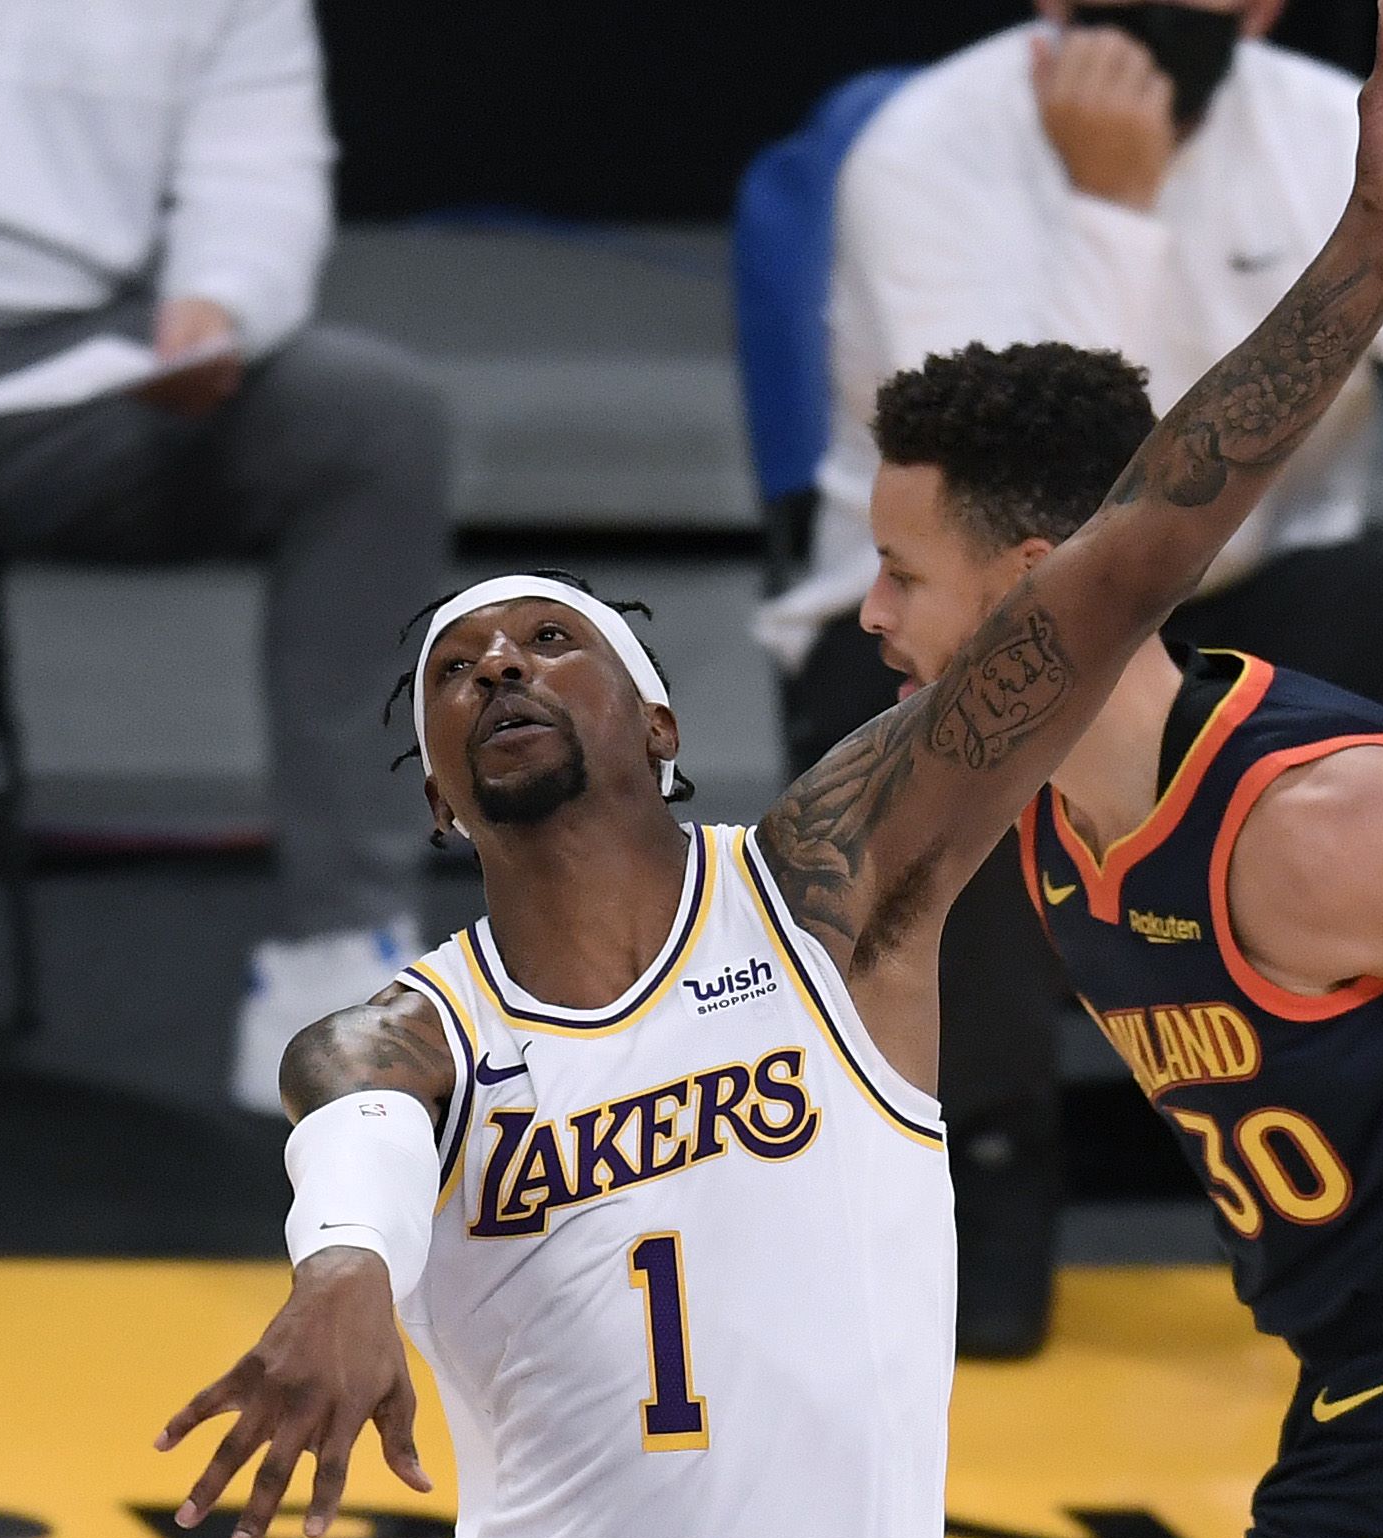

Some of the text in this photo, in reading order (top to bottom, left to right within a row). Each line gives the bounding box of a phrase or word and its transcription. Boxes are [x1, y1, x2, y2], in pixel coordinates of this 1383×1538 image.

[1128, 908, 1202, 941] Rakuten
[682, 957, 773, 1001] wish
[697, 983, 777, 1015] SHOPPING
[468, 1045, 822, 1240] LAKERS
[1163, 1106, 1354, 1241] 30
[628, 1230, 710, 1453] 1
